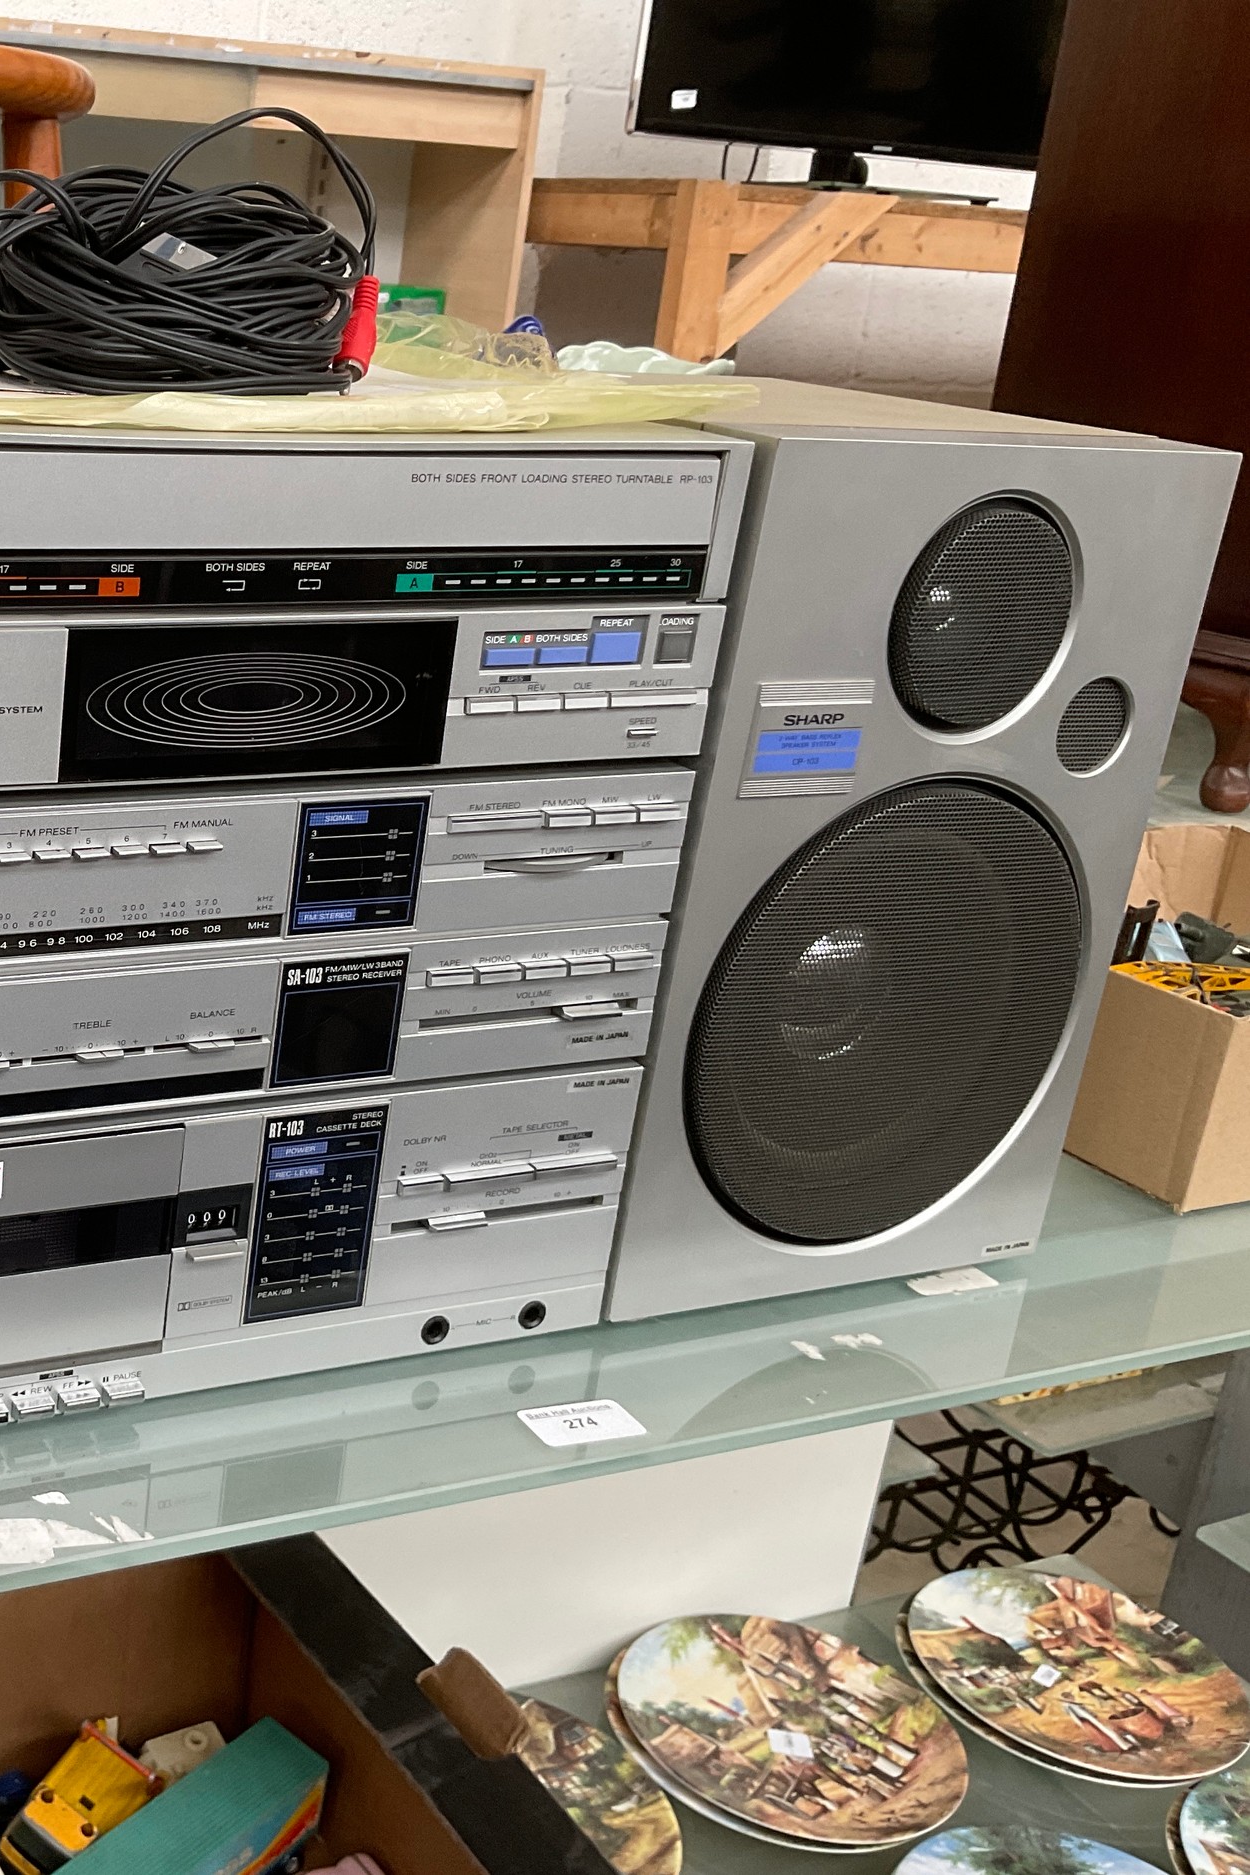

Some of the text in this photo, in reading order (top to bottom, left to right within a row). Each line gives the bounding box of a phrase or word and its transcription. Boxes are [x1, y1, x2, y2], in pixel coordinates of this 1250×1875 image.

[411, 473, 713, 485] BOTH SIDES FRONT LOADING STEREO TURNTABLE RP-103
[110, 563, 135, 573] SIDE
[205, 563, 266, 572] BOTH SIDES
[293, 562, 331, 571] REPEAT
[406, 561, 428, 570] SIDE
[513, 560, 523, 568] 17
[609, 559, 622, 568] 25
[670, 559, 682, 567] 30
[0, 565, 10, 575] 17
[116, 581, 125, 593] B
[409, 577, 419, 590] A
[599, 618, 634, 627] REPEAT
[485, 635, 506, 644] SIDE
[535, 633, 588, 643] BOTH SIDES
[527, 683, 545, 692] REV
[573, 682, 592, 690] CUE
[629, 679, 673, 687] PLAY/CUT
[478, 686, 500, 694] FWD
[628, 717, 657, 725] SPEED
[783, 713, 845, 726] SHARP
[485, 801, 521, 810] STEREO
[558, 797, 587, 806] MONO
[173, 818, 233, 829] FM MANUAL
[324, 814, 355, 823] SIGNAL
[19, 826, 79, 838] FM PRESET
[540, 846, 574, 855] TUNING
[452, 853, 478, 861] DOWN
[74, 934, 94, 944] 100
[104, 932, 124, 941] 102
[137, 929, 156, 939] 104
[170, 927, 189, 936] 106
[202, 925, 221, 934] 108
[247, 921, 270, 930] MHz
[571, 948, 599, 956] TUNER
[605, 943, 650, 953] LOUDNESS
[479, 954, 511, 963] PHONO
[531, 952, 549, 960] AUX
[439, 959, 461, 967] TAPE
[287, 962, 375, 986] SA-103 FM/MW/LW
[326, 969, 402, 983] STEREO RECEIVER
[516, 990, 552, 999] VOLUME
[190, 1009, 236, 1019] BALANCE
[73, 1019, 112, 1030] TREBLE
[571, 1031, 629, 1044] MADE IN JAPAN
[573, 1078, 630, 1088] MADE IN JAPAN
[352, 1110, 384, 1120] STEREO
[268, 1119, 305, 1138] RT-103
[316, 1119, 382, 1133] CASSETTE DECK
[502, 1120, 569, 1134] TAPE SELECTOR
[403, 1135, 447, 1146] DOLBY NR
[285, 1145, 316, 1155] POWER
[471, 1159, 502, 1167] NORMAL
[485, 1187, 520, 1197] RECORD
[257, 1287, 293, 1299] PEAK/dB
[113, 1371, 142, 1381] PAUSE
[30, 1386, 53, 1395] REW
[525, 1411, 550, 1420] Bank
[551, 1409, 569, 1417] Hall
[563, 1416, 598, 1429] 274
